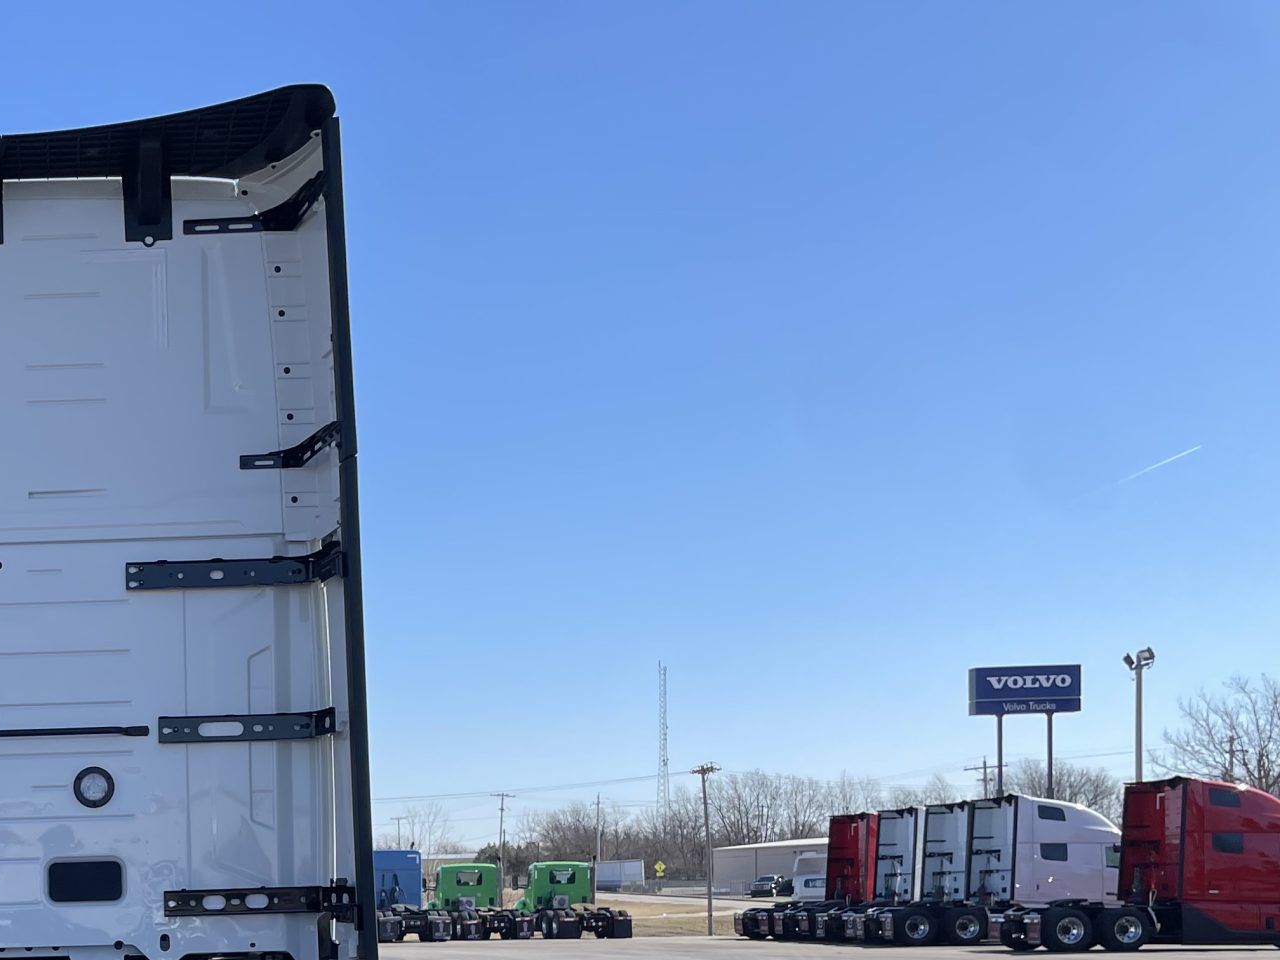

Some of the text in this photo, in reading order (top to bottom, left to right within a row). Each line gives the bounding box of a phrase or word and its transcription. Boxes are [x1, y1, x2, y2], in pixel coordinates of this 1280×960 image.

[986, 674, 1072, 689] VOLVO
[1002, 701, 1056, 712] Volvo Trucks
